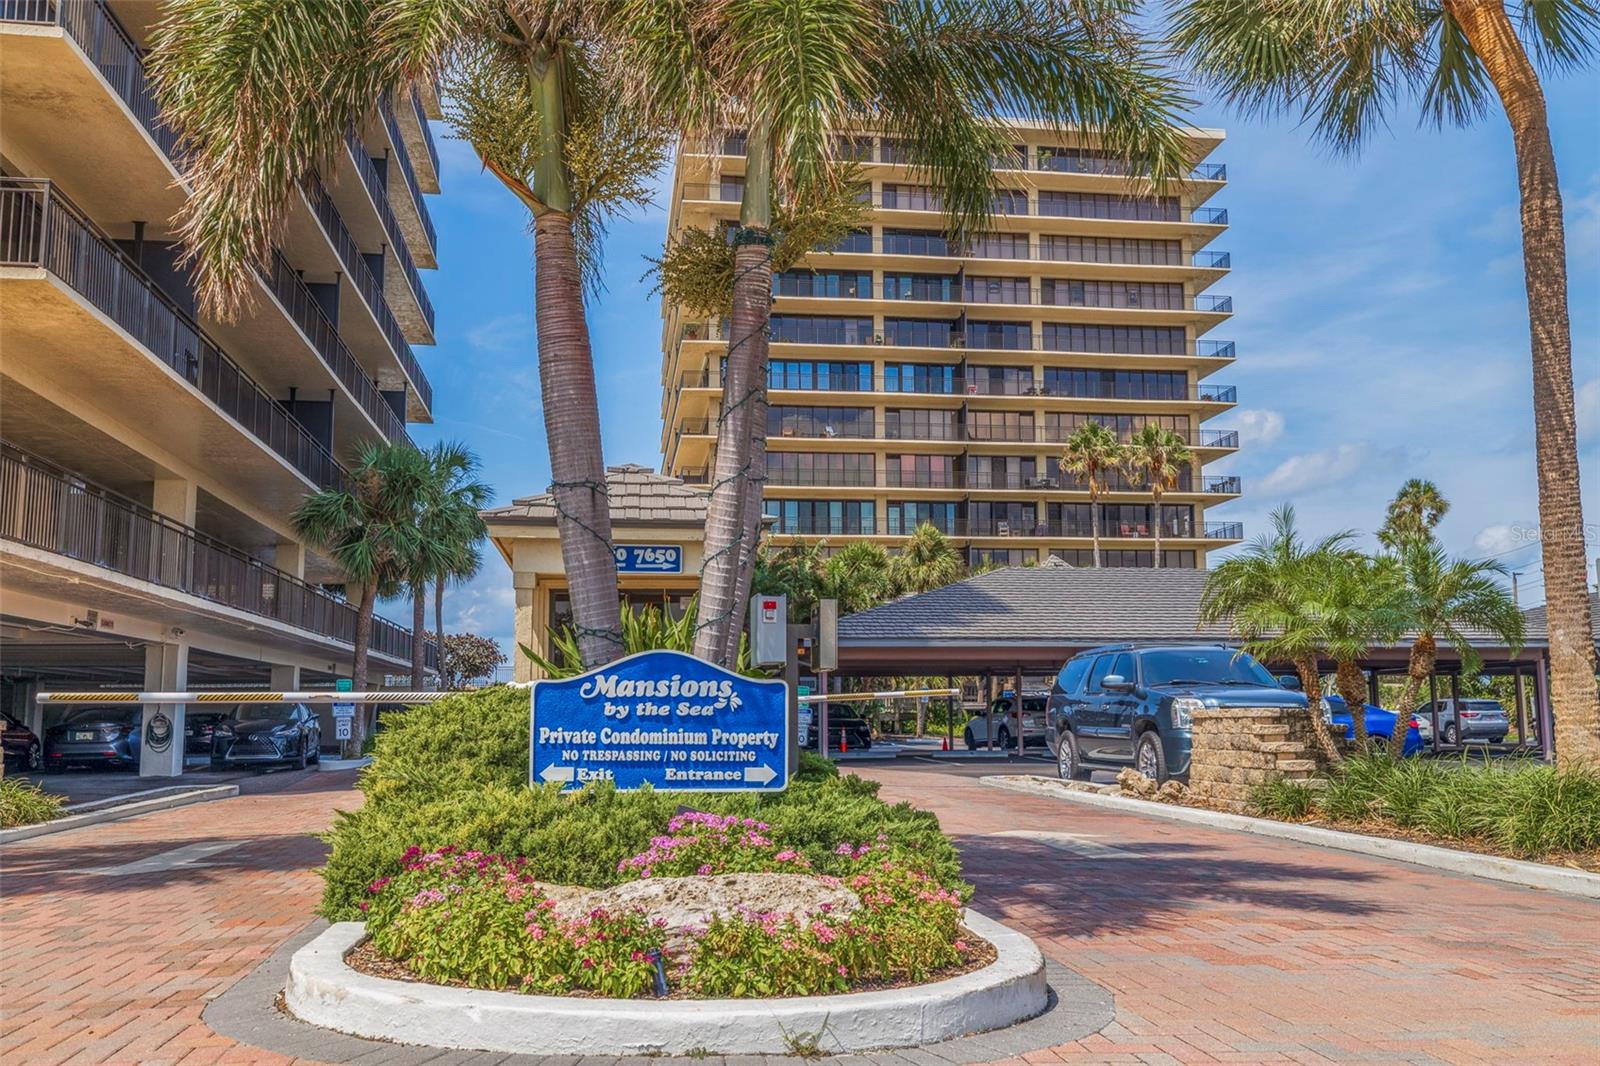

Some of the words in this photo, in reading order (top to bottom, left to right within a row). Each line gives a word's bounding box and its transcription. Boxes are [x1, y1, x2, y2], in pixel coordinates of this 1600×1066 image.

[633, 548, 677, 564] 7650
[580, 675, 733, 698] Mansions
[604, 702, 629, 719] by
[636, 702, 670, 716] the
[676, 702, 715, 716] Sea
[338, 728, 349, 737] 10
[539, 727, 597, 744] Private
[600, 727, 707, 745] Condominium
[711, 728, 779, 749] Property
[562, 750, 579, 761] NO
[582, 750, 661, 762] TRESPASSING
[670, 750, 687, 761] NO
[690, 750, 756, 762] SOLICITING
[576, 767, 614, 780] Exit
[665, 767, 742, 780] Entrance
